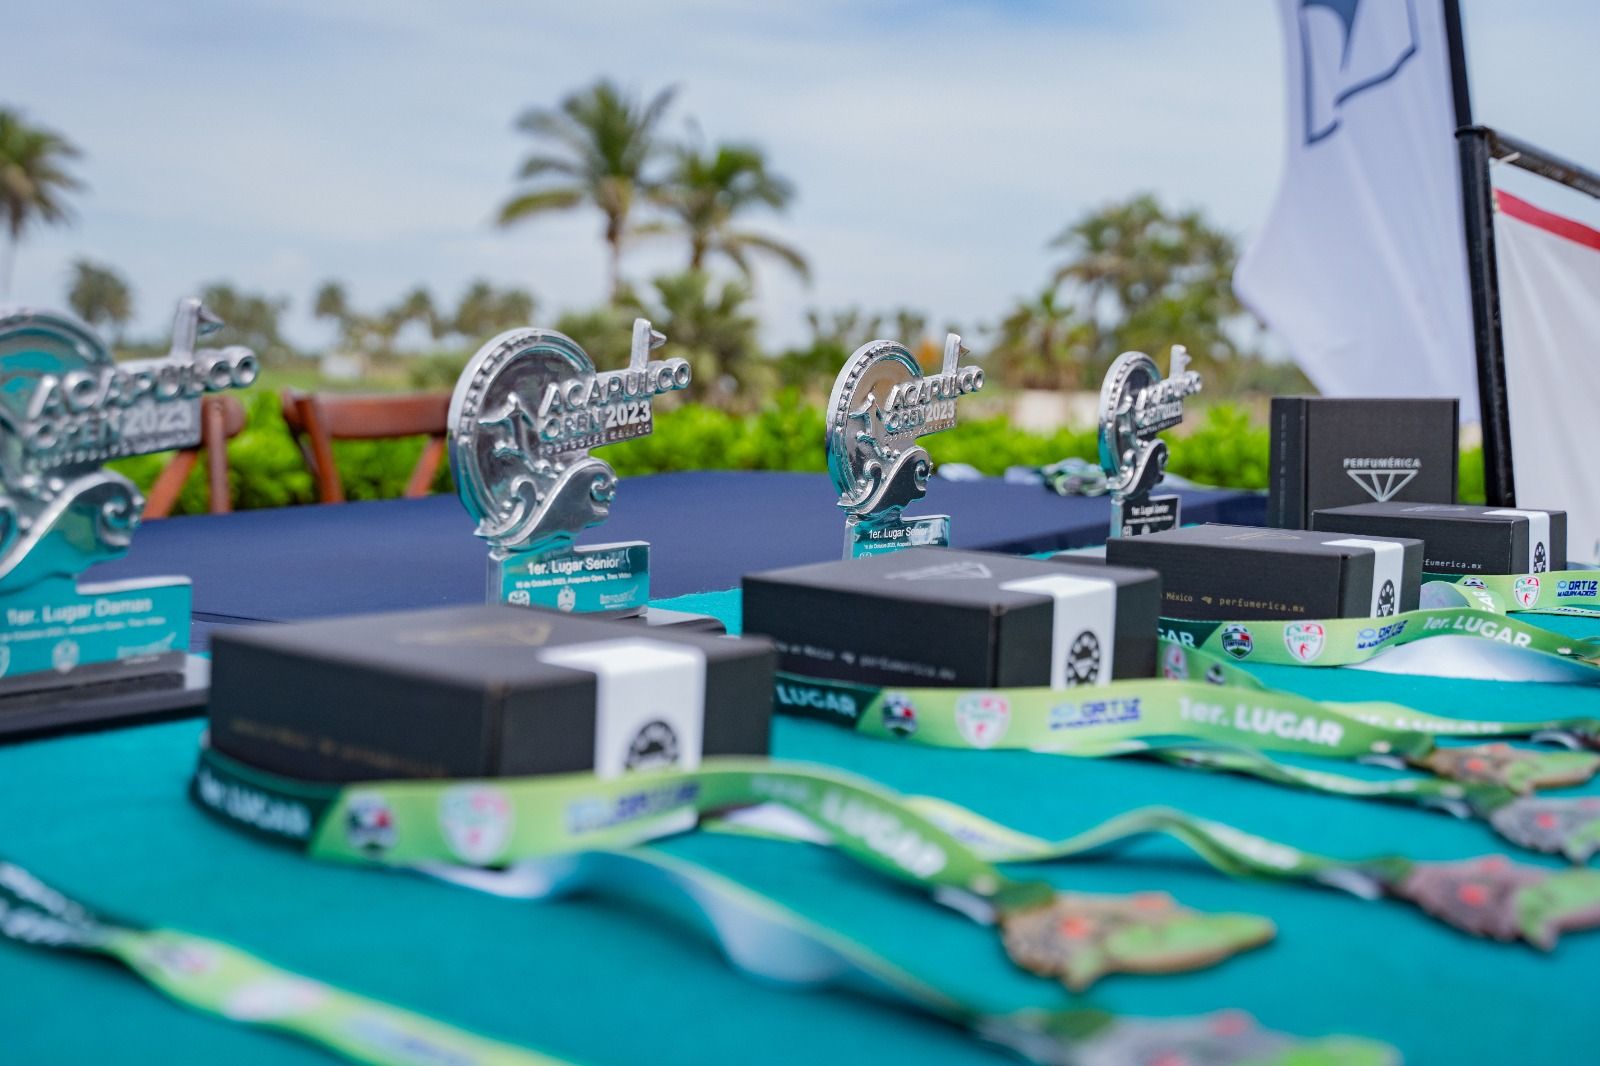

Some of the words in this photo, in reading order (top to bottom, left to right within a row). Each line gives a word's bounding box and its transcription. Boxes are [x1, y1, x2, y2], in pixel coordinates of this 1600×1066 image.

[538, 360, 691, 417] ACAPULCO
[884, 368, 984, 412] ACAPULCO
[121, 400, 193, 437] 2023
[538, 407, 602, 441] OPEN
[604, 400, 651, 429] 2023
[925, 400, 955, 422] 2023
[1343, 456, 1422, 468] PERFUMÉRICA
[868, 529, 882, 539] 1er.
[883, 528, 905, 540] Lugar
[528, 562, 549, 575] 1er.
[551, 559, 584, 575] Lugar
[585, 556, 620, 571] Senior
[1423, 558, 1482, 569] fumerica.mx
[1568, 580, 1598, 590] ORTIZ
[1166, 592, 1193, 603] México
[1219, 598, 1305, 613] perfumerica.mx
[1422, 616, 1449, 631] 1er.
[1452, 615, 1532, 648] LUGAR
[775, 685, 857, 718] LUGAR
[1179, 696, 1230, 727] 1er.
[1233, 704, 1344, 747] LUGAR
